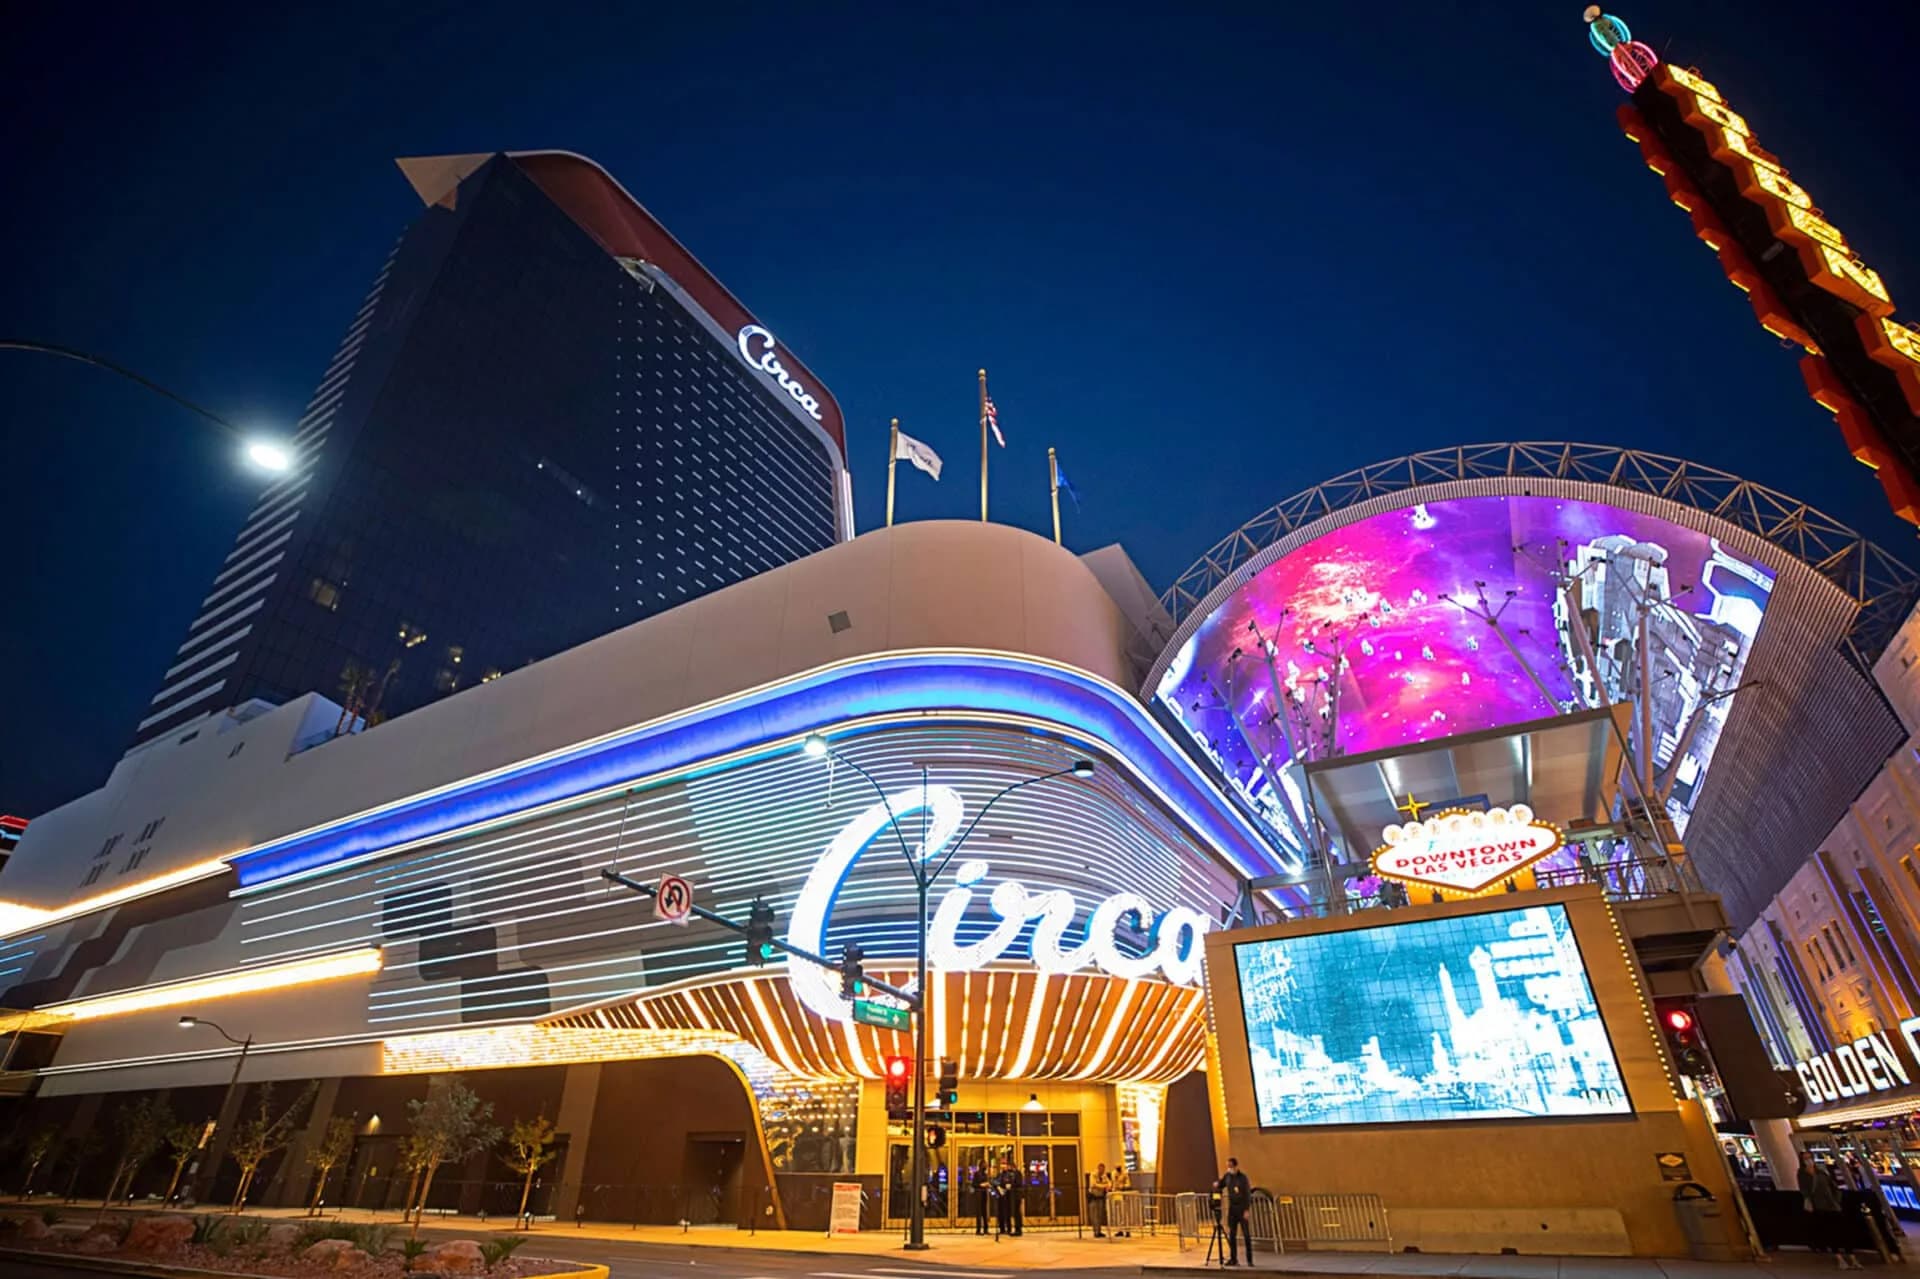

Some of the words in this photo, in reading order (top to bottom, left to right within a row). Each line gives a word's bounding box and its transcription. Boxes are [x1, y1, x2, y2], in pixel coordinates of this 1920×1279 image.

[1668, 64, 1890, 302] GOLDEN
[738, 324, 822, 420] Circa
[1396, 838, 1536, 867] DOWNTOWN
[1414, 863, 1448, 875] LAS
[1456, 851, 1522, 868] VEGAS
[788, 784, 1210, 1020] Circa
[1796, 1030, 1911, 1104] GOLDEN
